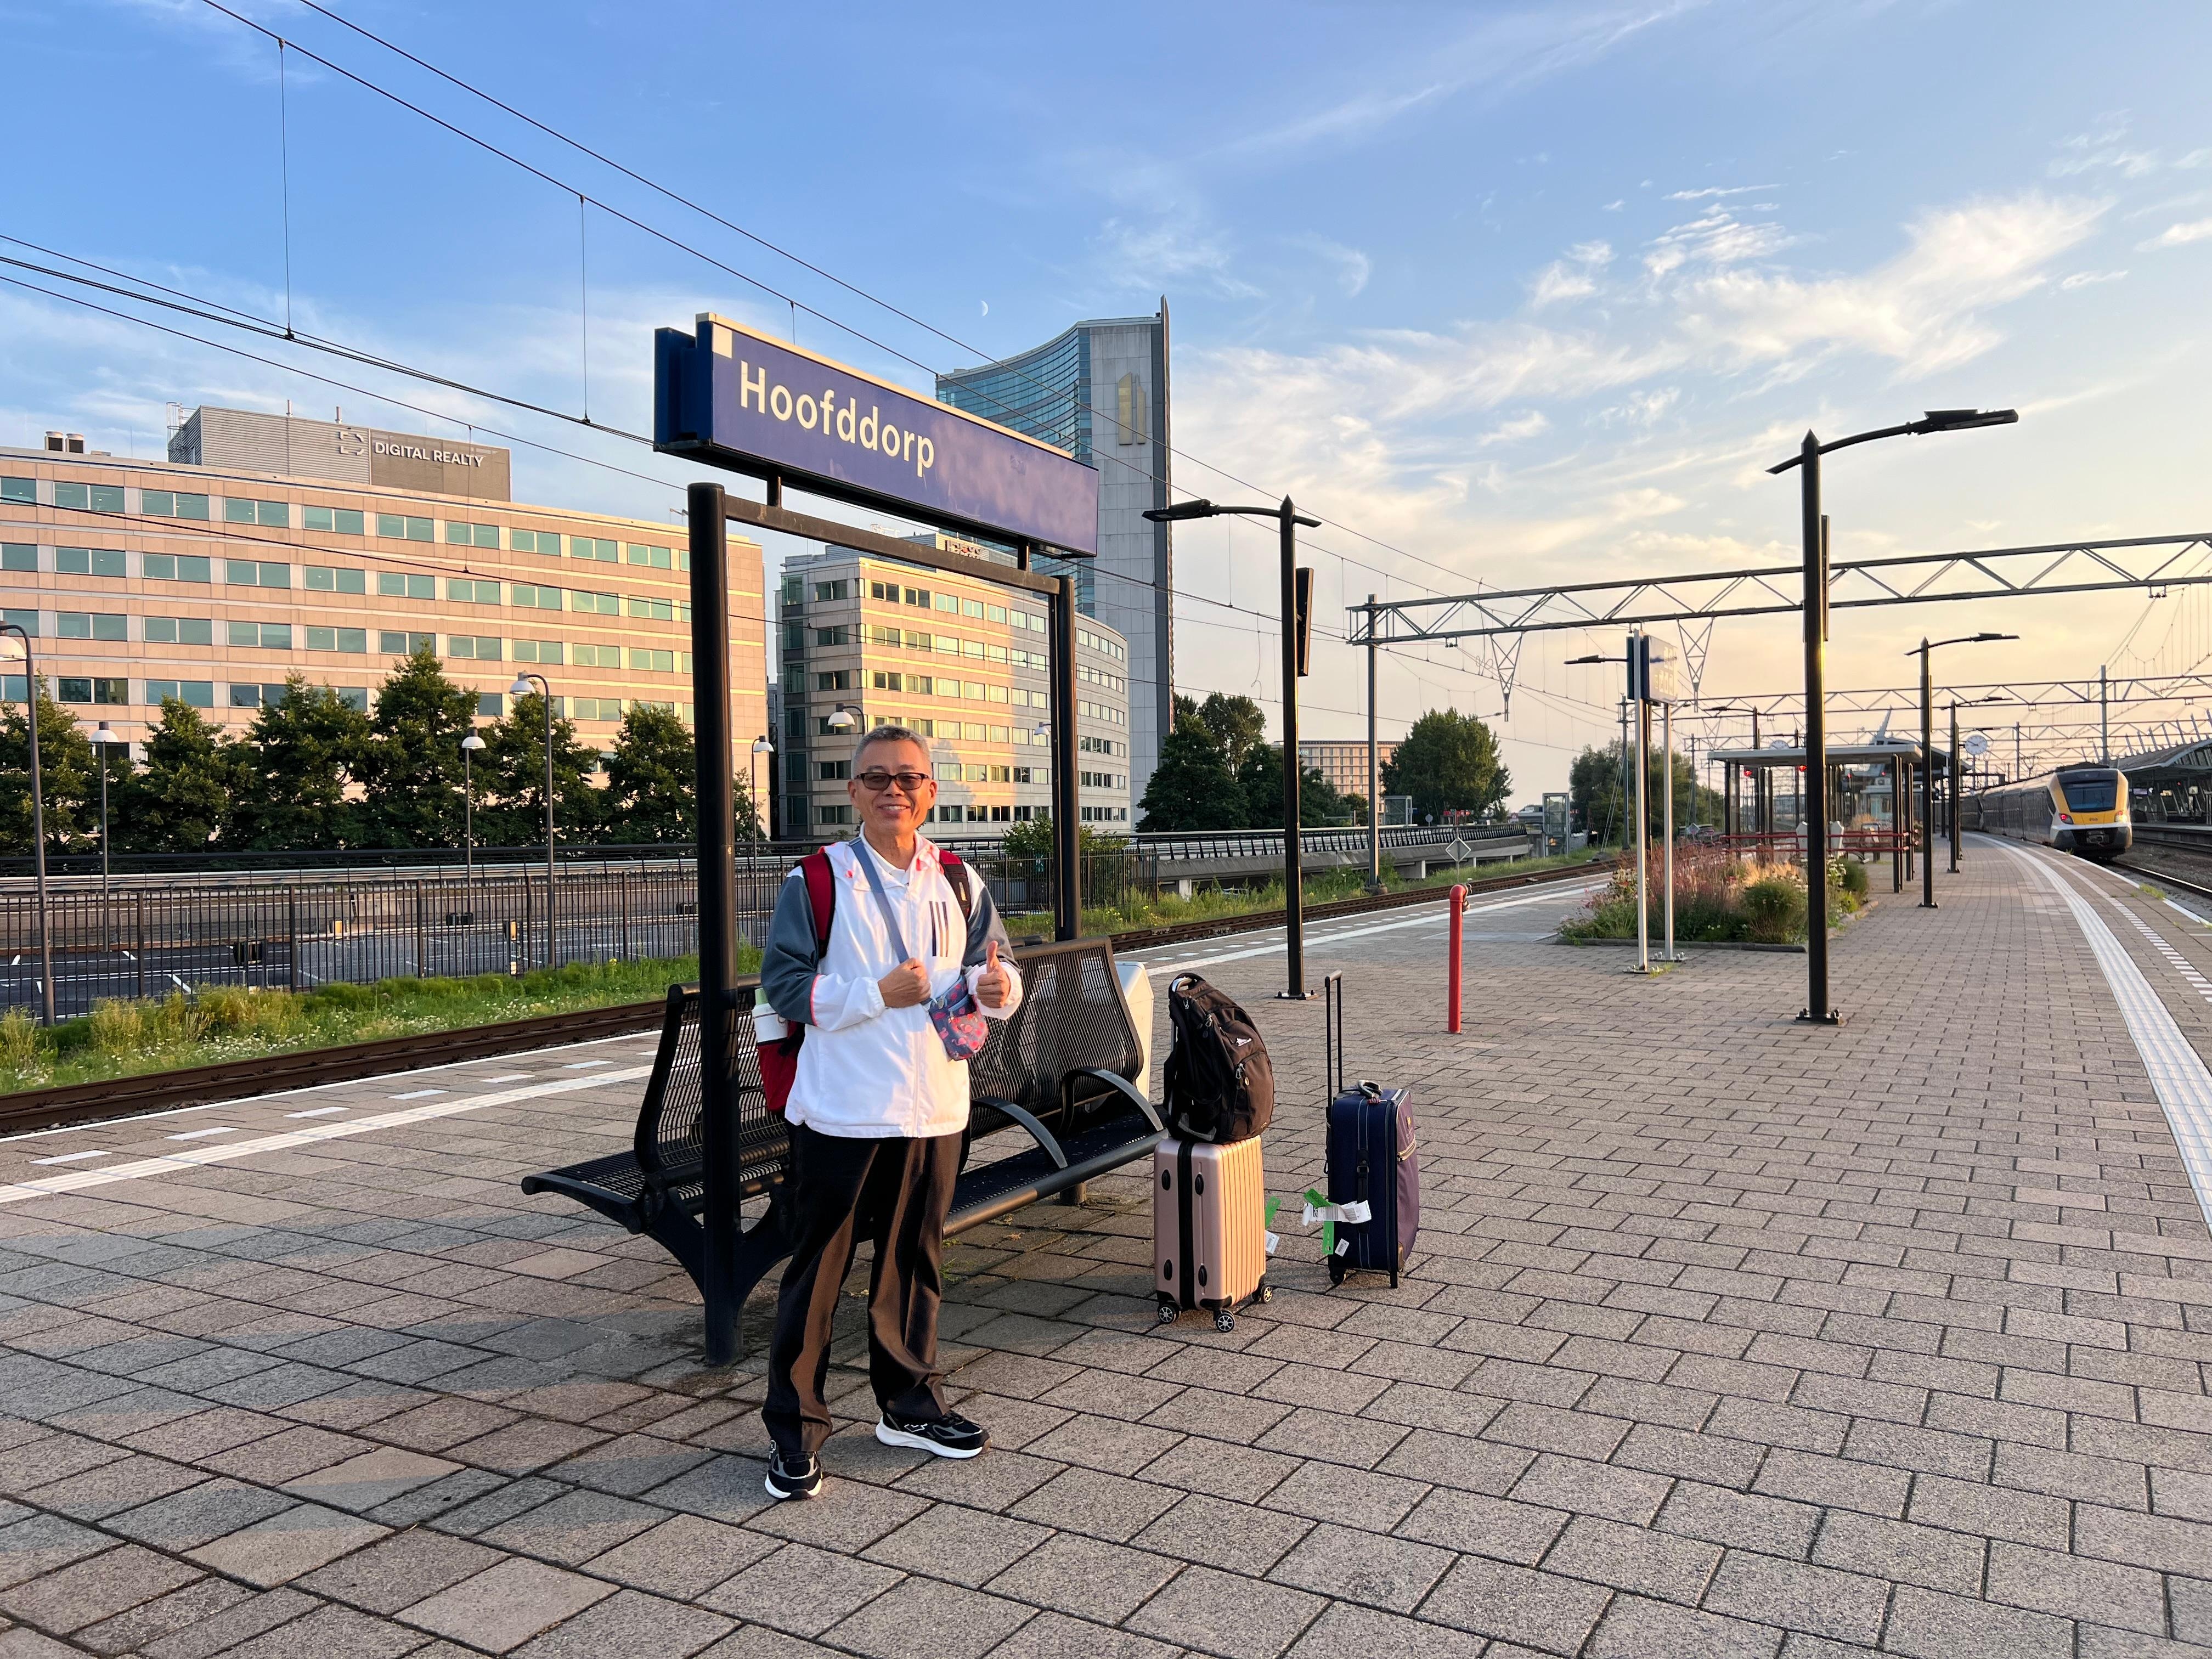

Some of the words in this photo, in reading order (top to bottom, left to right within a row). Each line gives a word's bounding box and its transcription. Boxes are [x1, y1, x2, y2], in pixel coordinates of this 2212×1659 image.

[375, 442, 430, 461] DIGITAL
[433, 449, 484, 467] REALTY
[740, 359, 934, 478] Hoofddorp
